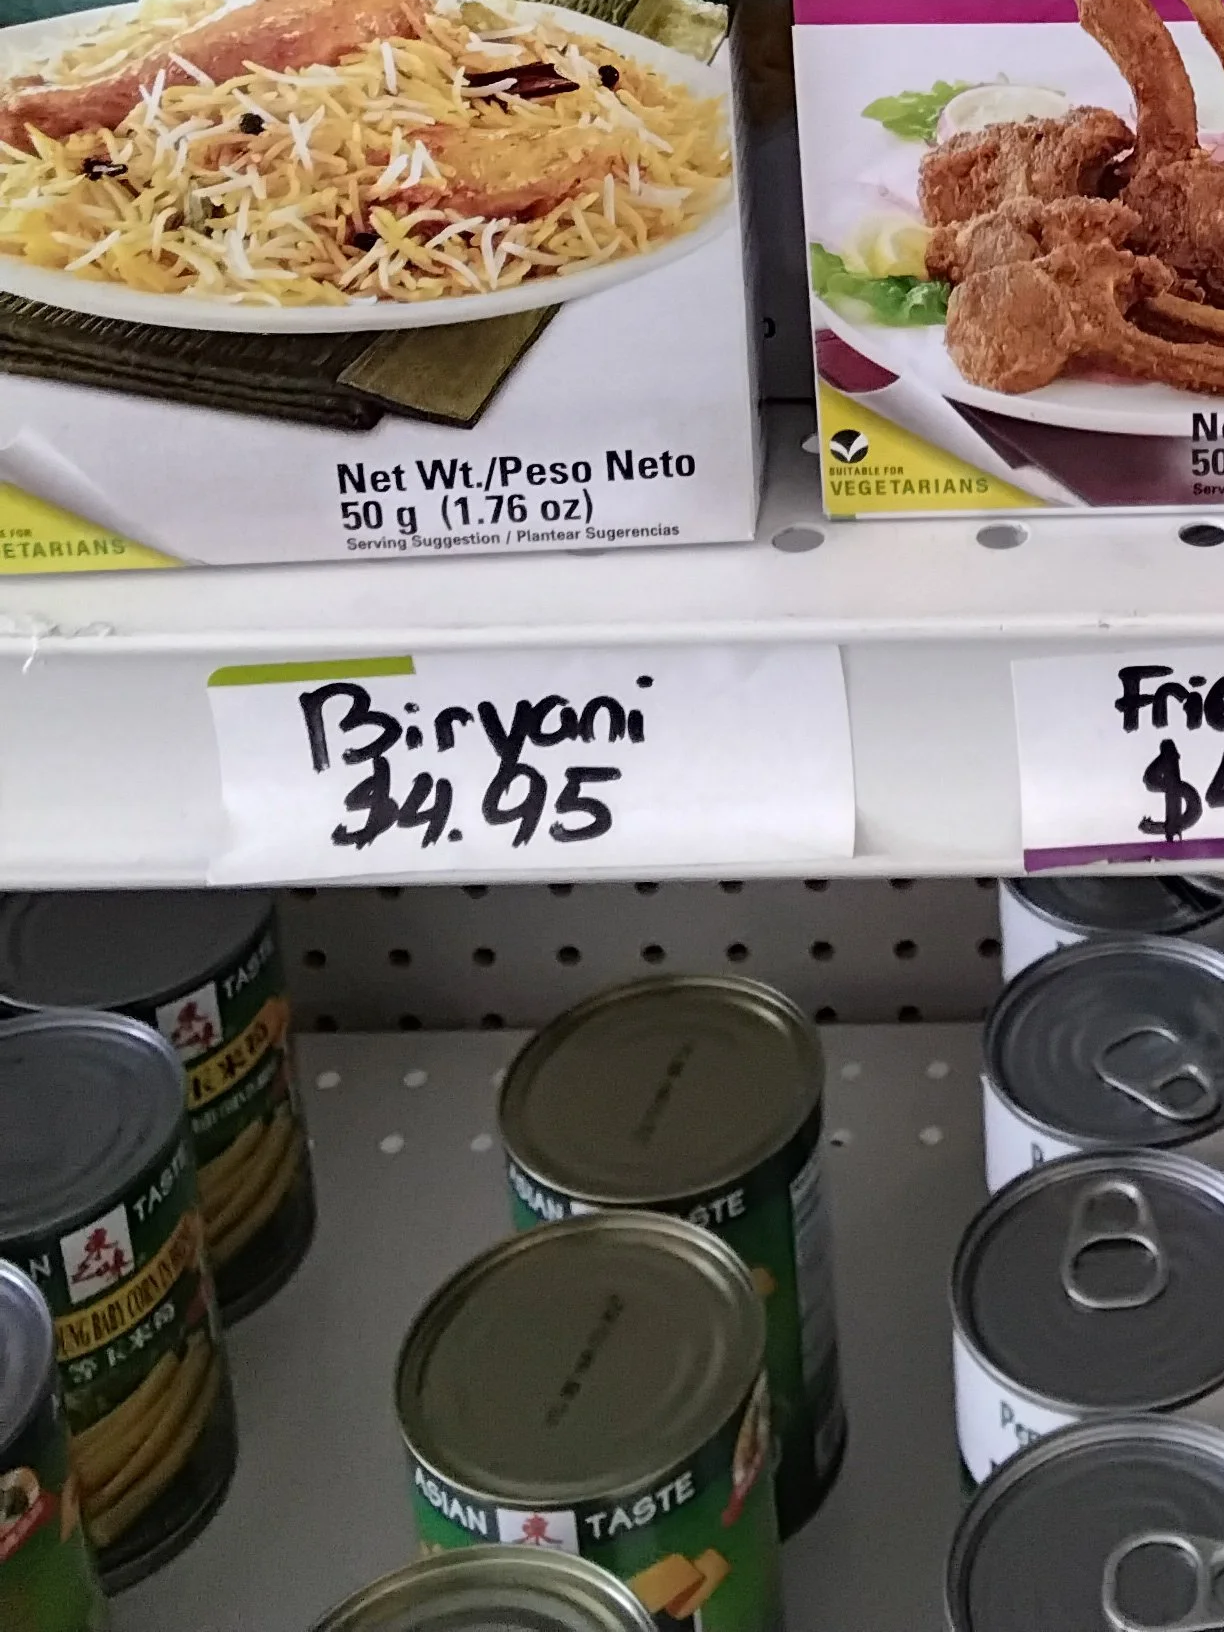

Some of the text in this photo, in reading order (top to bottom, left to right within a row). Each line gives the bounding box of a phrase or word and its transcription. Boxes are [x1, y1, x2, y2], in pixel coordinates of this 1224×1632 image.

[337, 450, 695, 494] Net Wt./Peso Neto
[829, 467, 903, 476] SUITABLE FOR
[830, 475, 994, 496] VEGETARIANS
[341, 489, 592, 535] 50 g (1.76 oz)
[2, 536, 128, 559] ETARIANS
[347, 520, 679, 551] Serving Suggestion / Plantear Sugerencias
[299, 675, 654, 774] Biryani
[414, 1467, 490, 1535] ASIAN
[584, 1471, 696, 1540] TASTE
